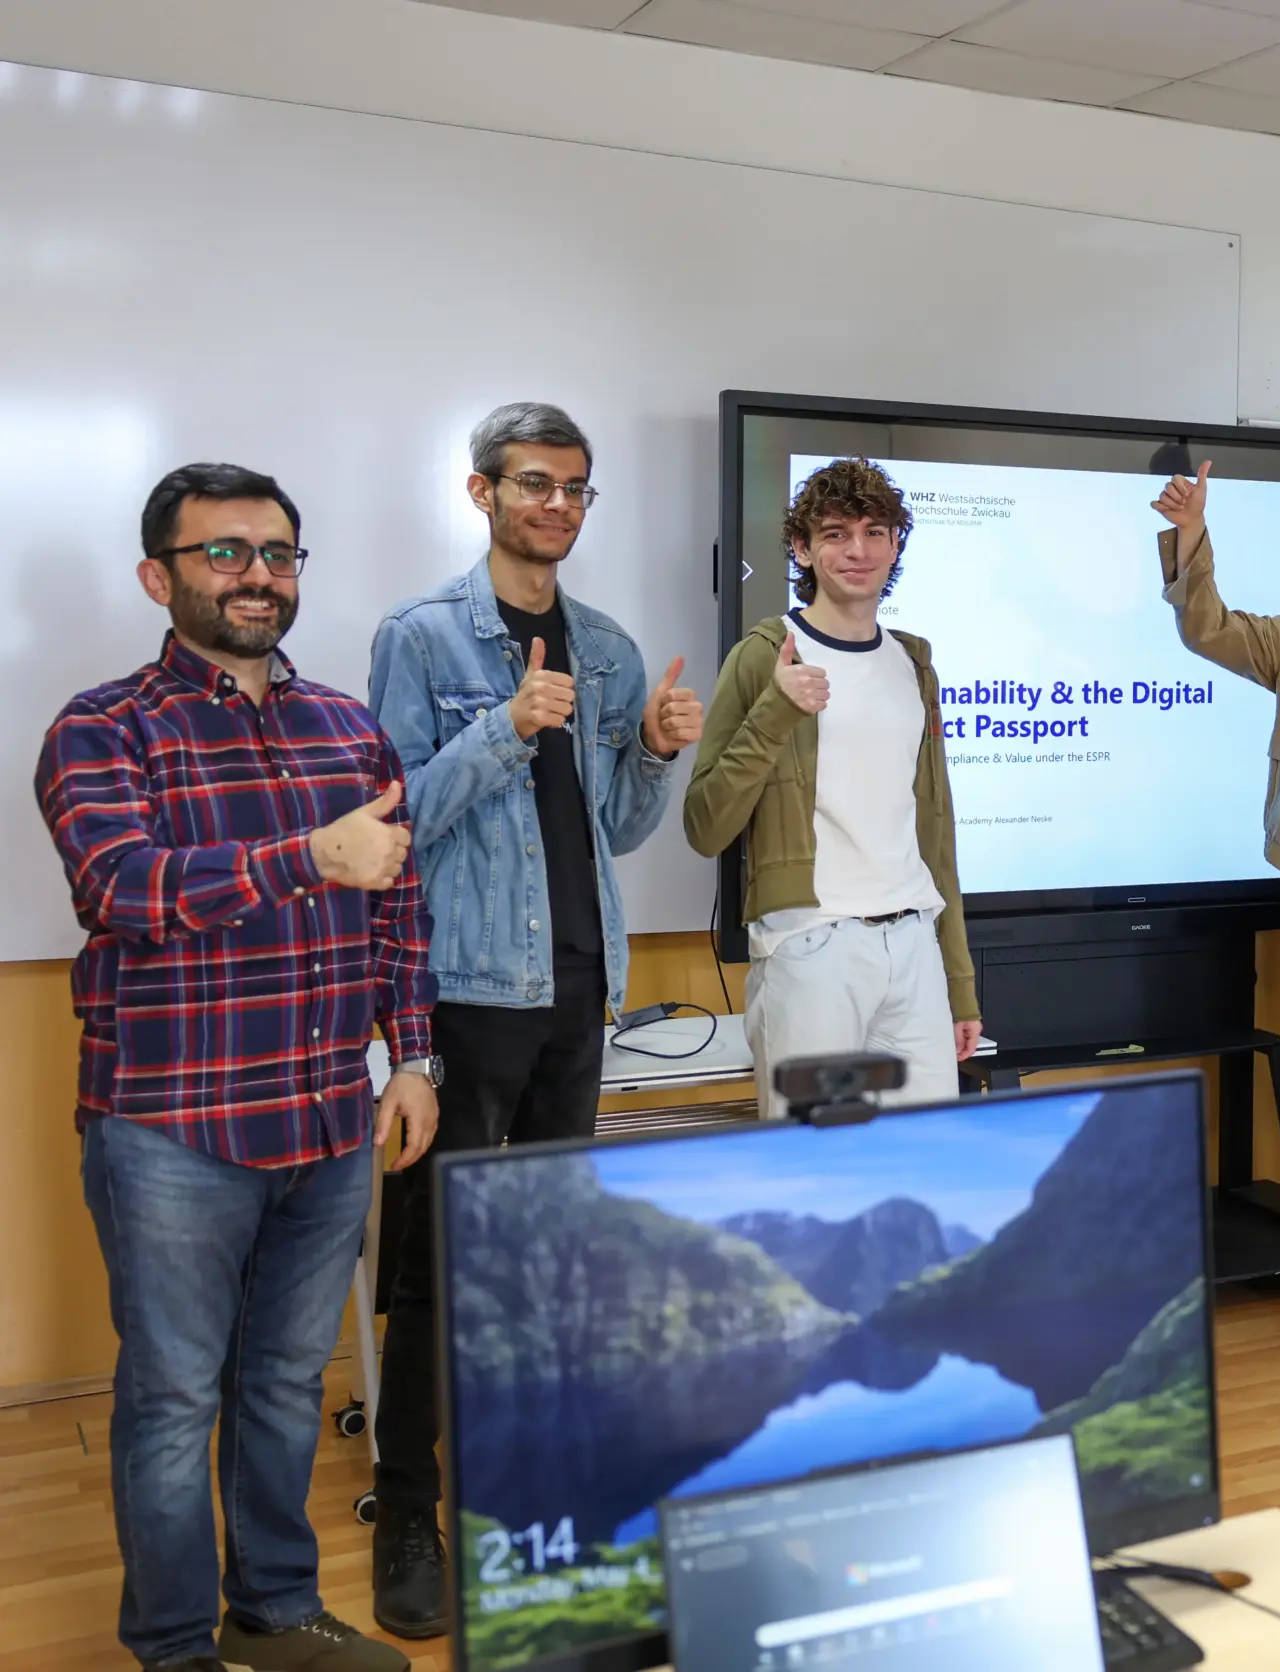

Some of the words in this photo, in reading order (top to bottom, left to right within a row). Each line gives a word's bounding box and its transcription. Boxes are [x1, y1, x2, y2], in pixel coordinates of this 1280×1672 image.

[910, 491, 936, 502] WHZ
[938, 493, 1017, 506] Westsächsische
[911, 504, 969, 517] Hochschule
[971, 507, 1011, 518] Zwickau
[941, 679, 1043, 712] nability
[1050, 681, 1074, 705] &
[1081, 680, 1124, 705] the
[1132, 680, 1213, 711] Digital
[975, 714, 1089, 744] Passport
[992, 753, 1002, 764] &
[1005, 753, 1033, 763] Value
[1035, 752, 1064, 763] under
[1067, 752, 1084, 762] the
[1086, 751, 1111, 762] ESPR
[959, 816, 993, 826] Academy
[994, 814, 1030, 824] Alexander
[475, 1516, 580, 1583] 2:14
